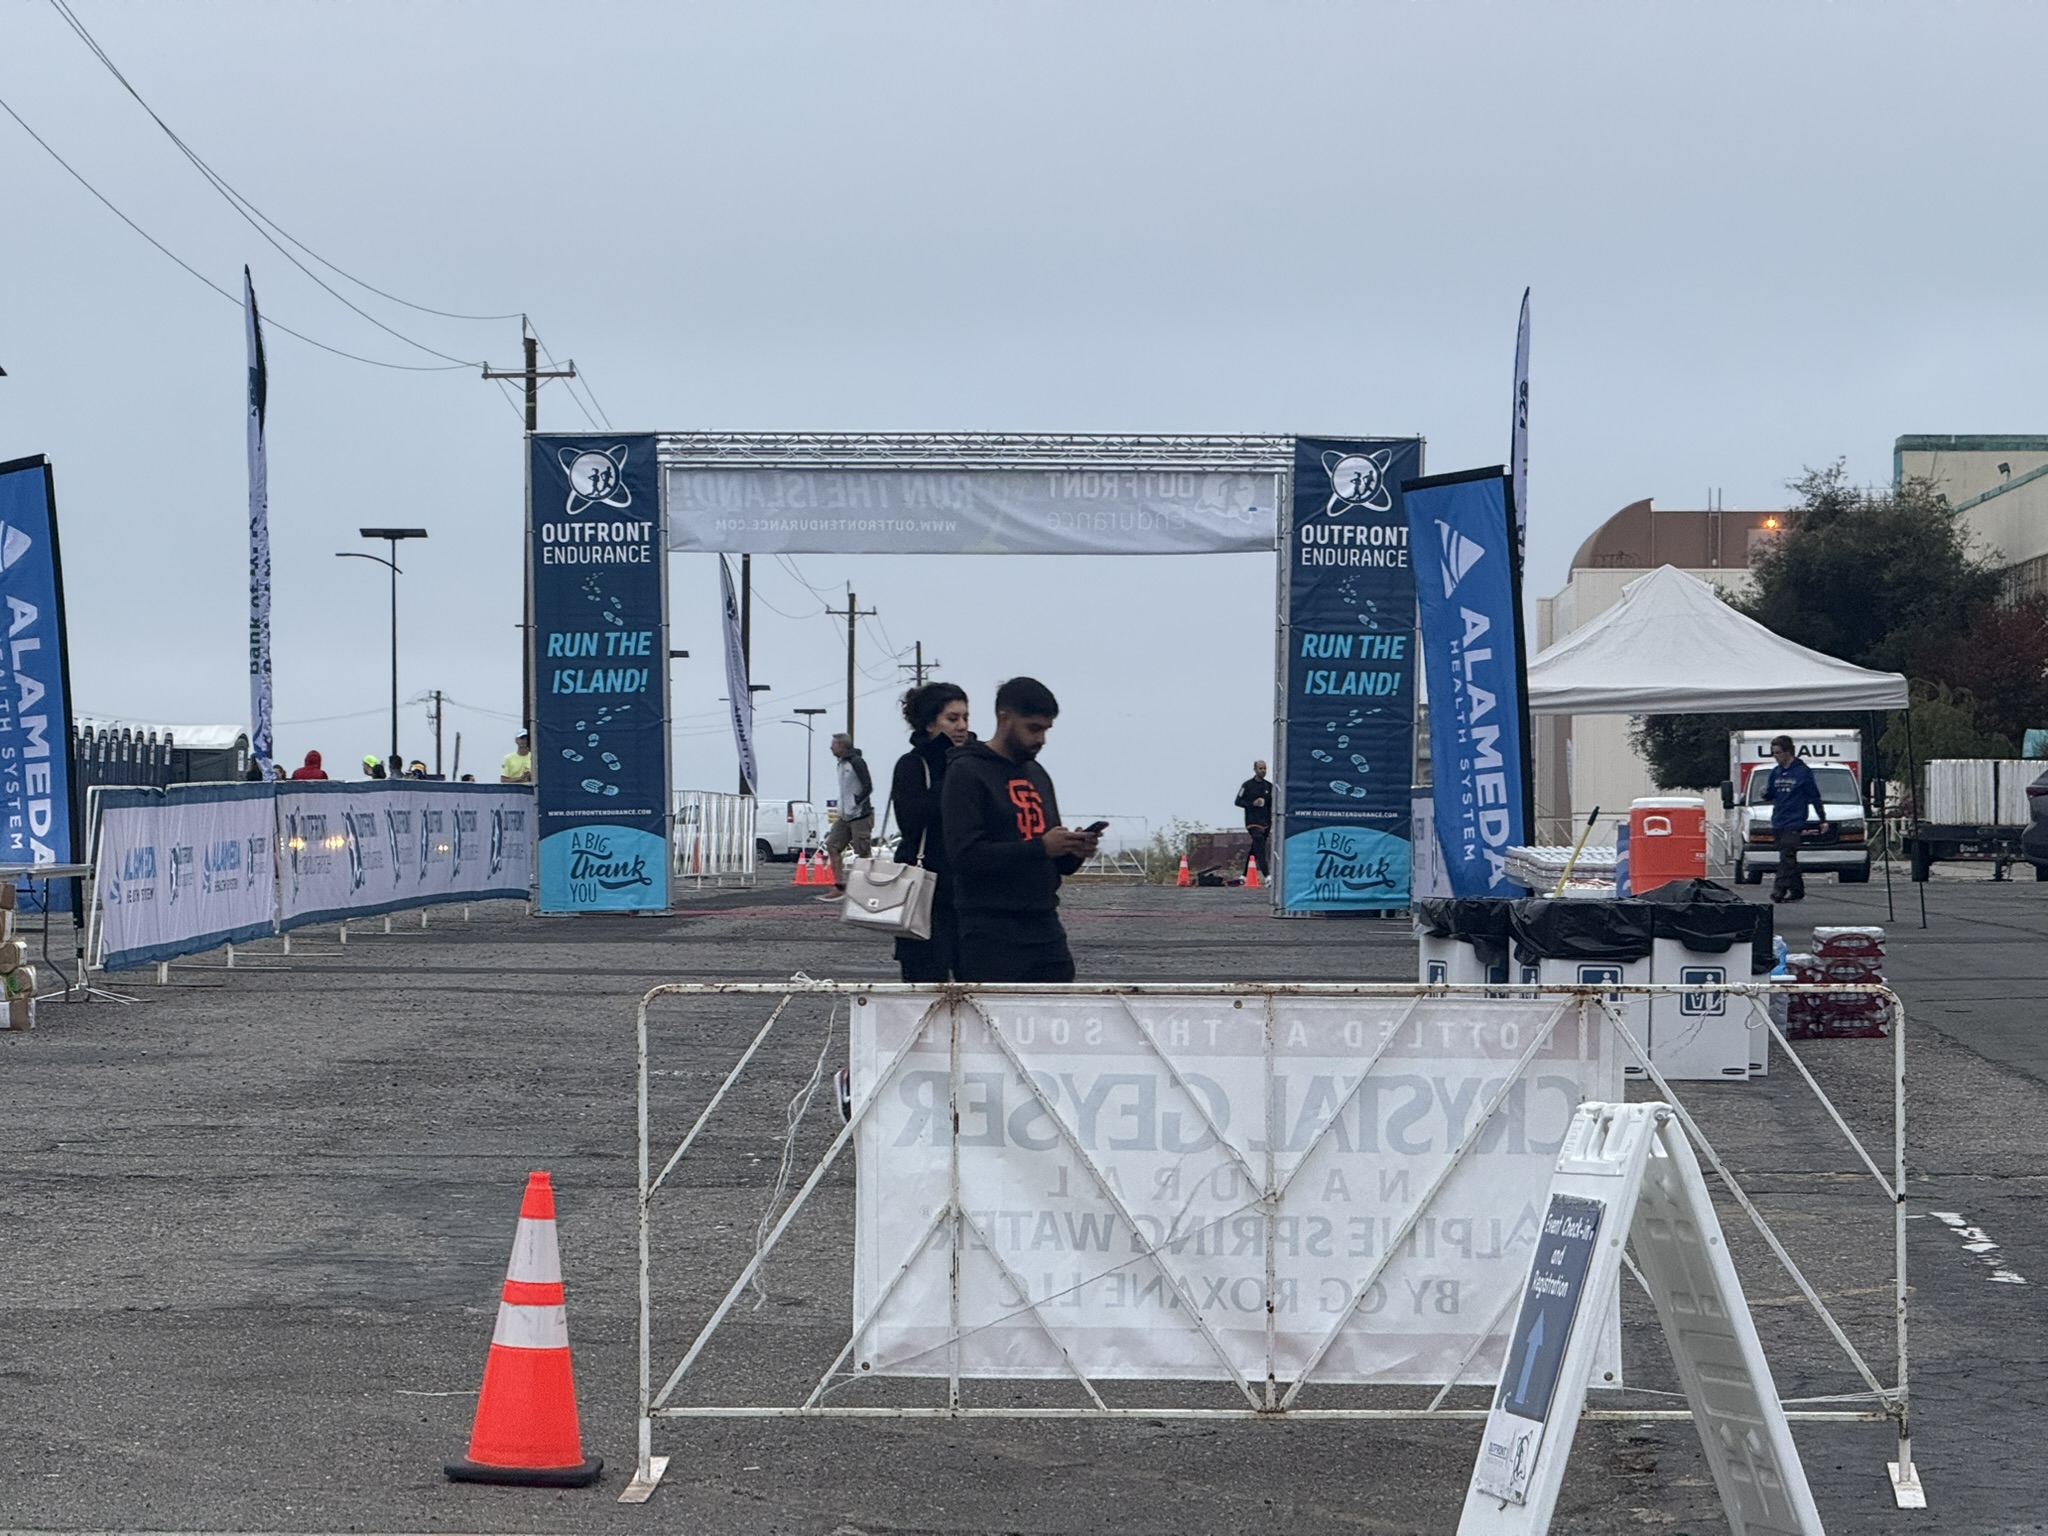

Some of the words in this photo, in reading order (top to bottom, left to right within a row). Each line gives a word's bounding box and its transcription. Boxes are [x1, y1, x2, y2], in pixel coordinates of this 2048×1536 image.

[541, 522, 653, 543] OUTFRONT
[1301, 524, 1409, 546] OUTFRONT
[543, 545, 651, 564] ENDURANCE
[1302, 548, 1408, 567] ENDURANCE
[547, 632, 598, 657] RUN
[605, 631, 653, 656] THE
[1301, 634, 1353, 659] RUN
[1359, 635, 1407, 660] THE
[552, 668, 649, 694] ISLAND!
[1304, 670, 1401, 697] ISLAND!
[6, 594, 56, 865] ALAMEDA
[1450, 640, 1467, 743] HEALTH
[1459, 758, 1475, 861] SYSTEM
[1460, 606, 1510, 889] ALAMEDA
[1758, 744, 1840, 758] UAUL
[2, 747, 23, 849] SYSTEM
[571, 832, 581, 849] A
[585, 832, 611, 853] BIG
[1317, 832, 1327, 849] A
[1330, 832, 1356, 854] BIG
[570, 849, 652, 890] Thank
[1315, 849, 1397, 890] Thank
[569, 883, 597, 903] YOU
[1314, 883, 1340, 901] YOU
[1544, 1213, 1565, 1236] Event
[1550, 1244, 1567, 1266] and
[1531, 1269, 1569, 1299] Registration
